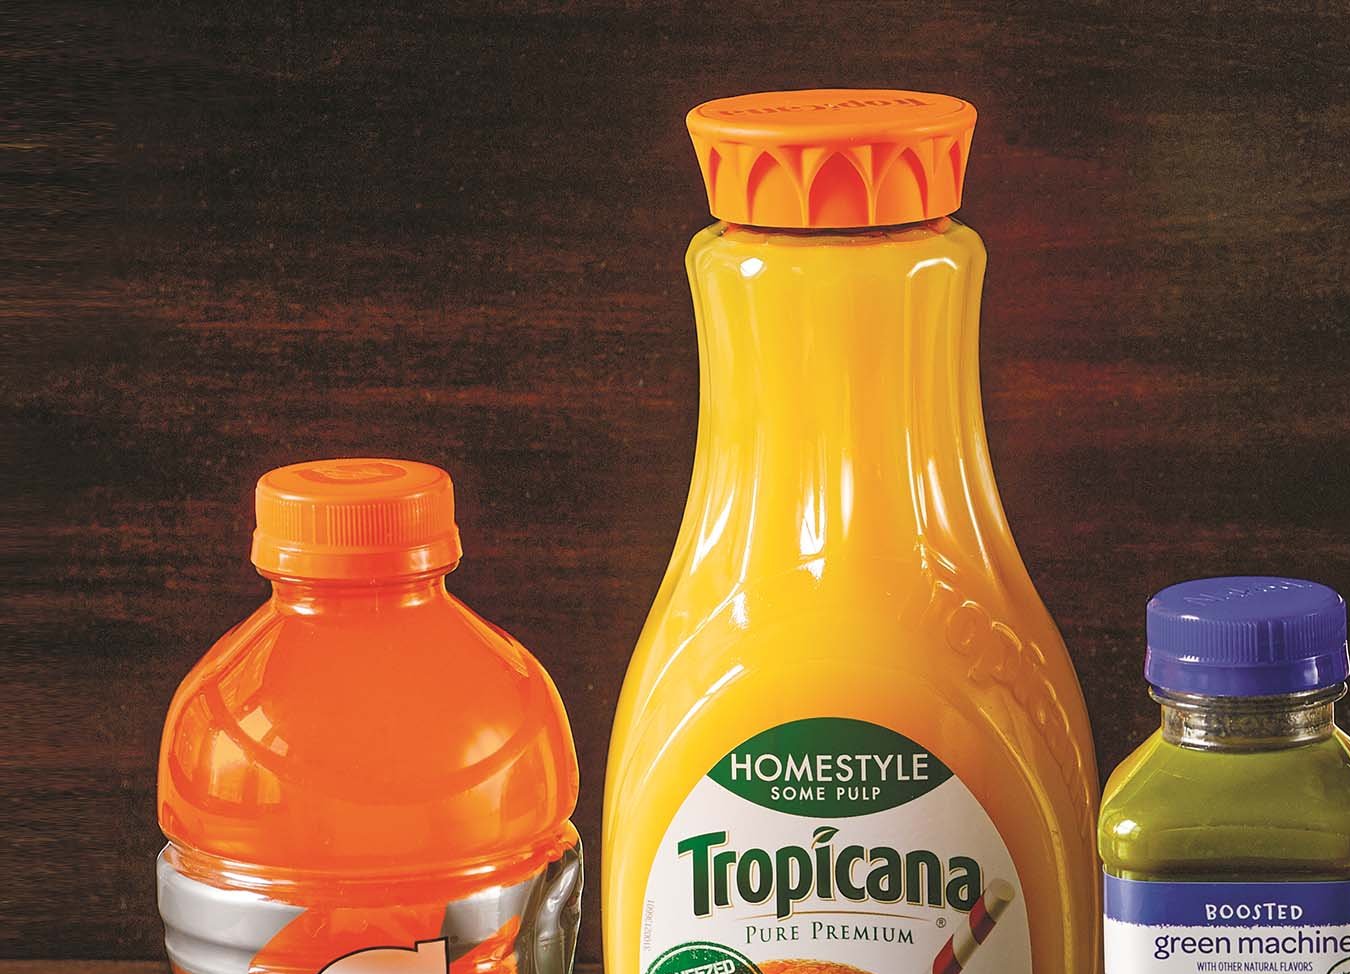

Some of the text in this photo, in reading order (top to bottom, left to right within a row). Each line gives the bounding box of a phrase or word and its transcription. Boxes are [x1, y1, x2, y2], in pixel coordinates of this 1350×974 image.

[731, 752, 929, 783] HOMESTYLE
[771, 785, 881, 801] SOME PULP
[677, 828, 986, 920] Tropicana
[1205, 902, 1304, 921] BOOSTED
[745, 921, 915, 945] PURE PREMIUM
[1154, 935, 1231, 960] green
[1197, 961, 1313, 973] WITH OTHER NATURAL FLAVORS
